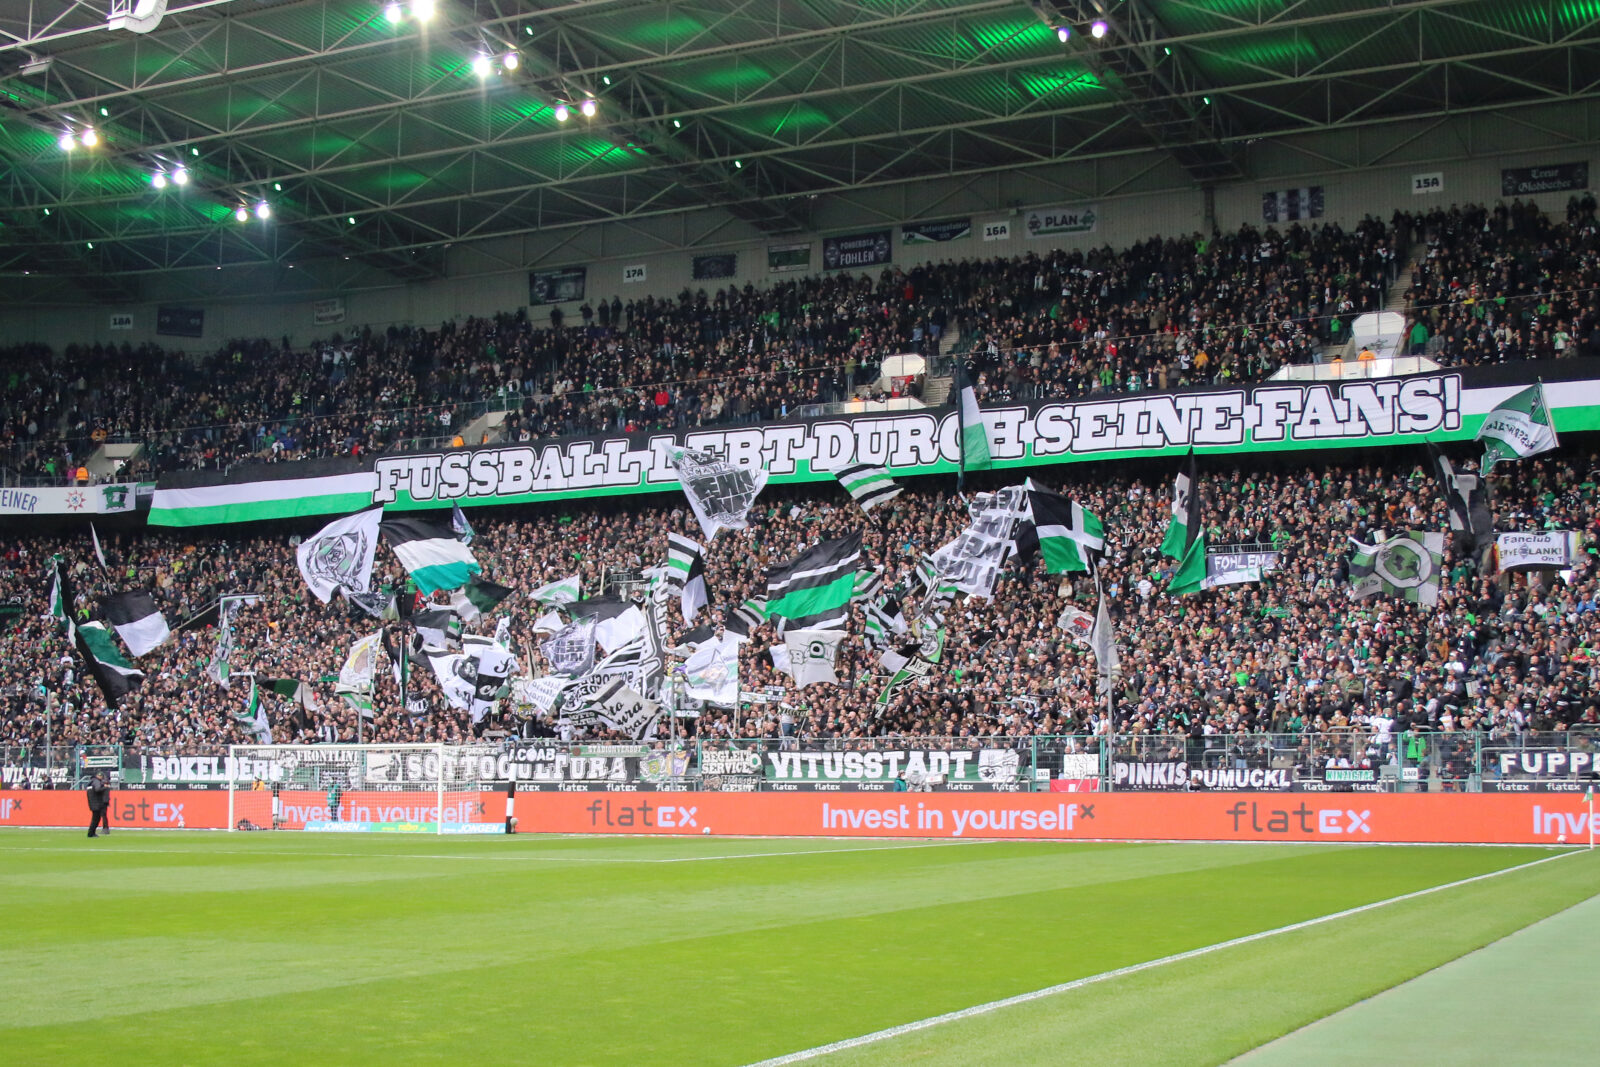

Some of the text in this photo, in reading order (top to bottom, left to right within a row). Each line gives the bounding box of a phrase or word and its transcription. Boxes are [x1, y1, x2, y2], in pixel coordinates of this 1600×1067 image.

[1415, 177, 1440, 189] 15A
[986, 225, 1007, 236] 16A
[840, 250, 875, 265] FOHLEN
[625, 268, 643, 279] 17A
[112, 317, 131, 326] 18A
[374, 438, 641, 503] FUSSBALL
[1033, 389, 1247, 456] SEINE
[1251, 373, 1463, 442] FANS!
[1503, 535, 1552, 544] Fanclub
[1214, 554, 1266, 570] FOHLEN
[767, 751, 973, 779] VITUSSTADT
[1115, 762, 1188, 785] PINKIS
[558, 783, 588, 791] flatex
[606, 783, 637, 791] flatex
[1496, 783, 1529, 791] flatex
[822, 803, 1078, 836] Invest in yourself
